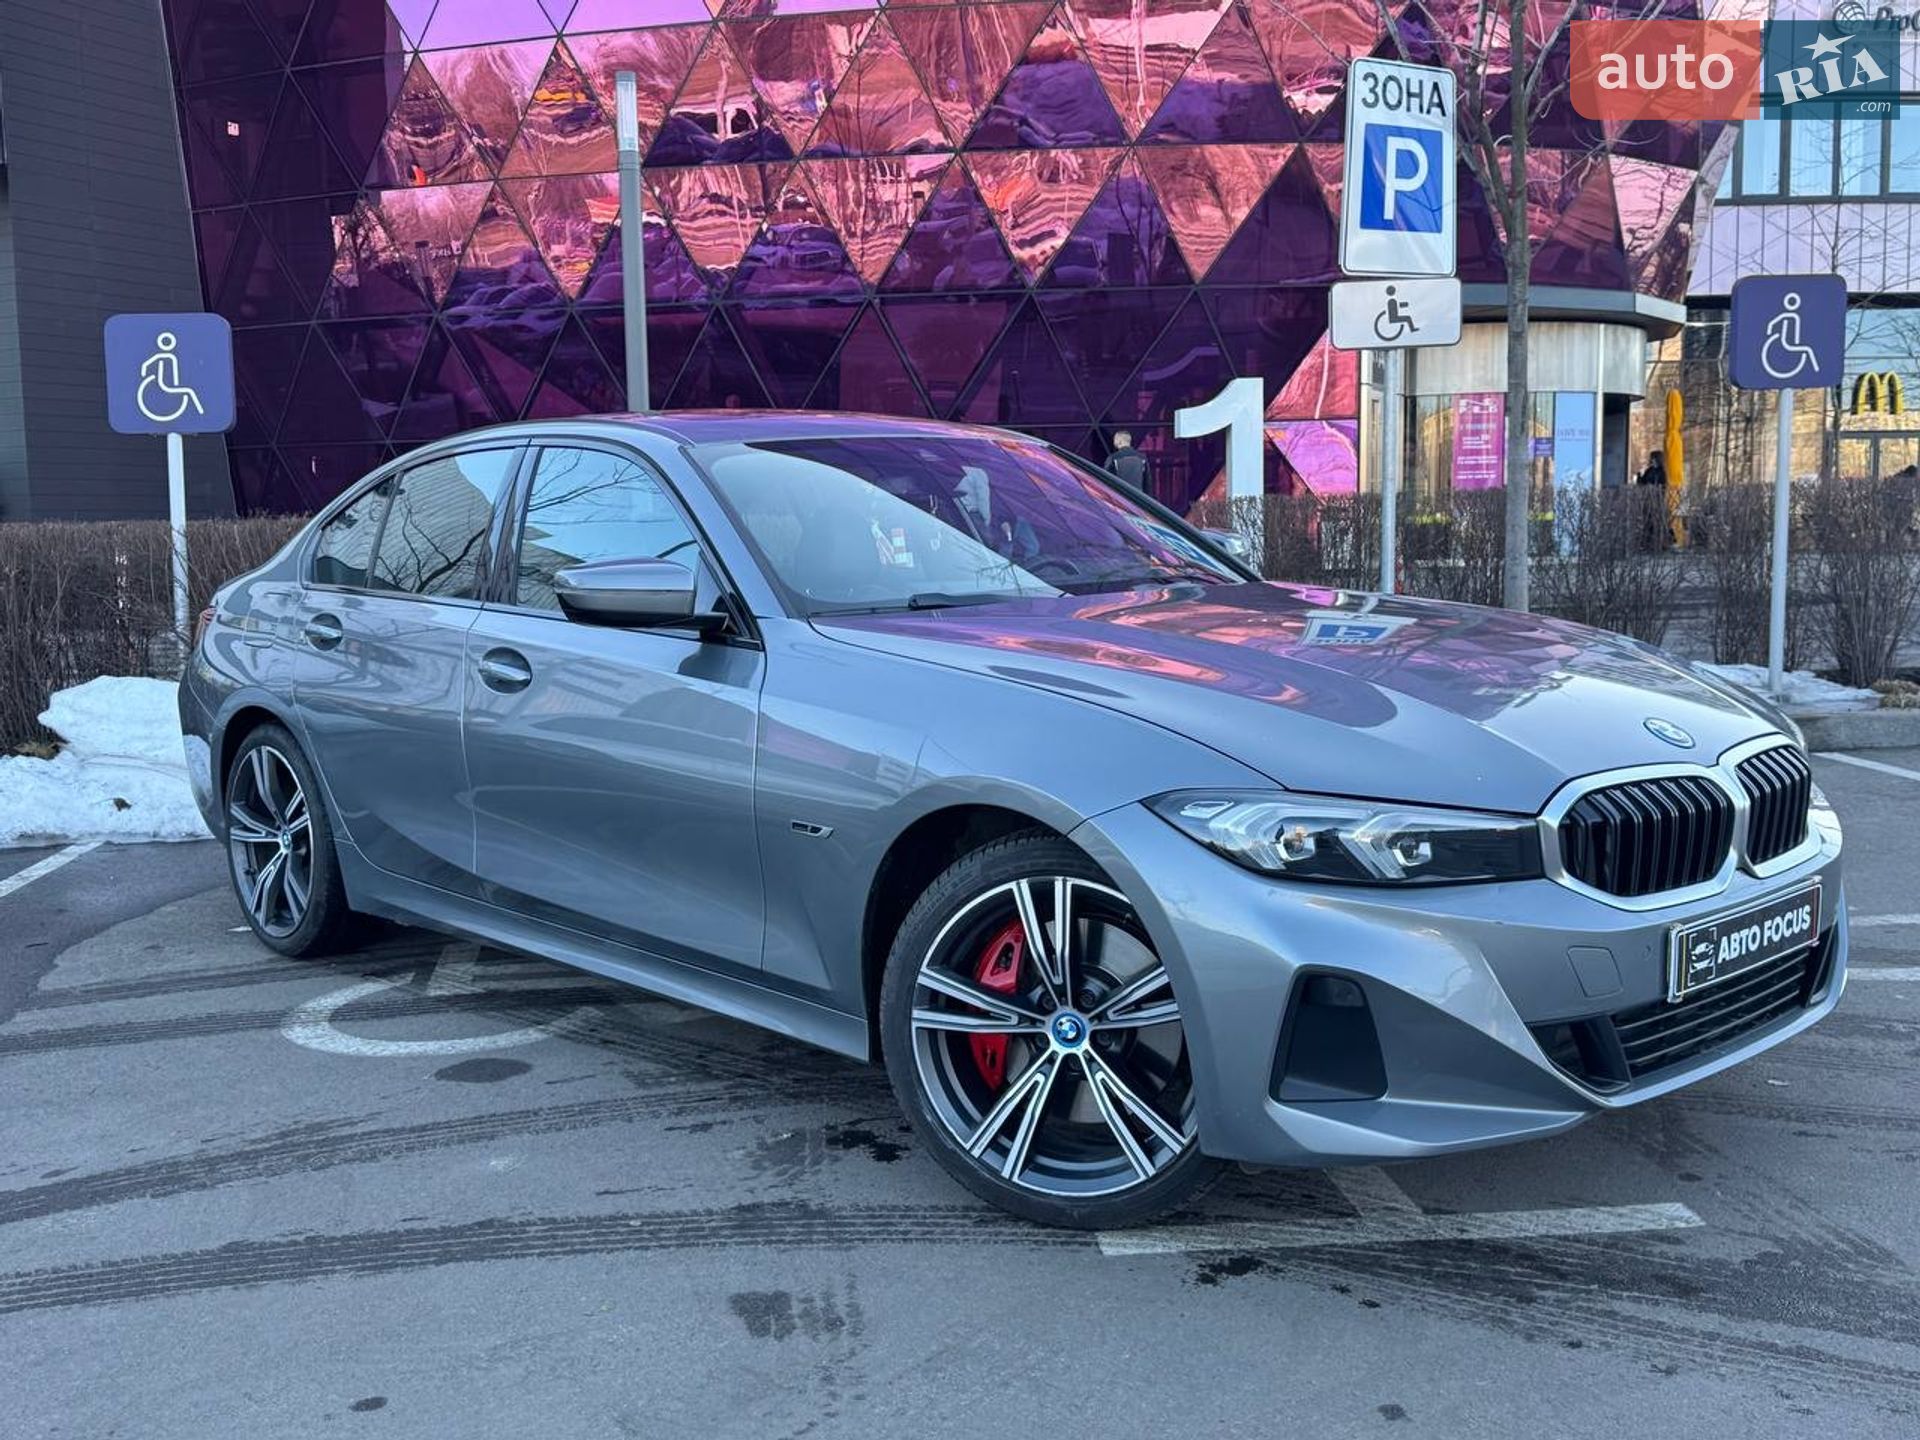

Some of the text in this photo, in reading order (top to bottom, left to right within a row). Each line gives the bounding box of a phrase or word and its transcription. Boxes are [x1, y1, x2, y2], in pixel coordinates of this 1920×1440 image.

[1361, 72, 1447, 117] ЗОНА
[1383, 136, 1429, 220] P
[1174, 376, 1264, 499] 1
[1717, 905, 1811, 964] АВТО FOCUS
